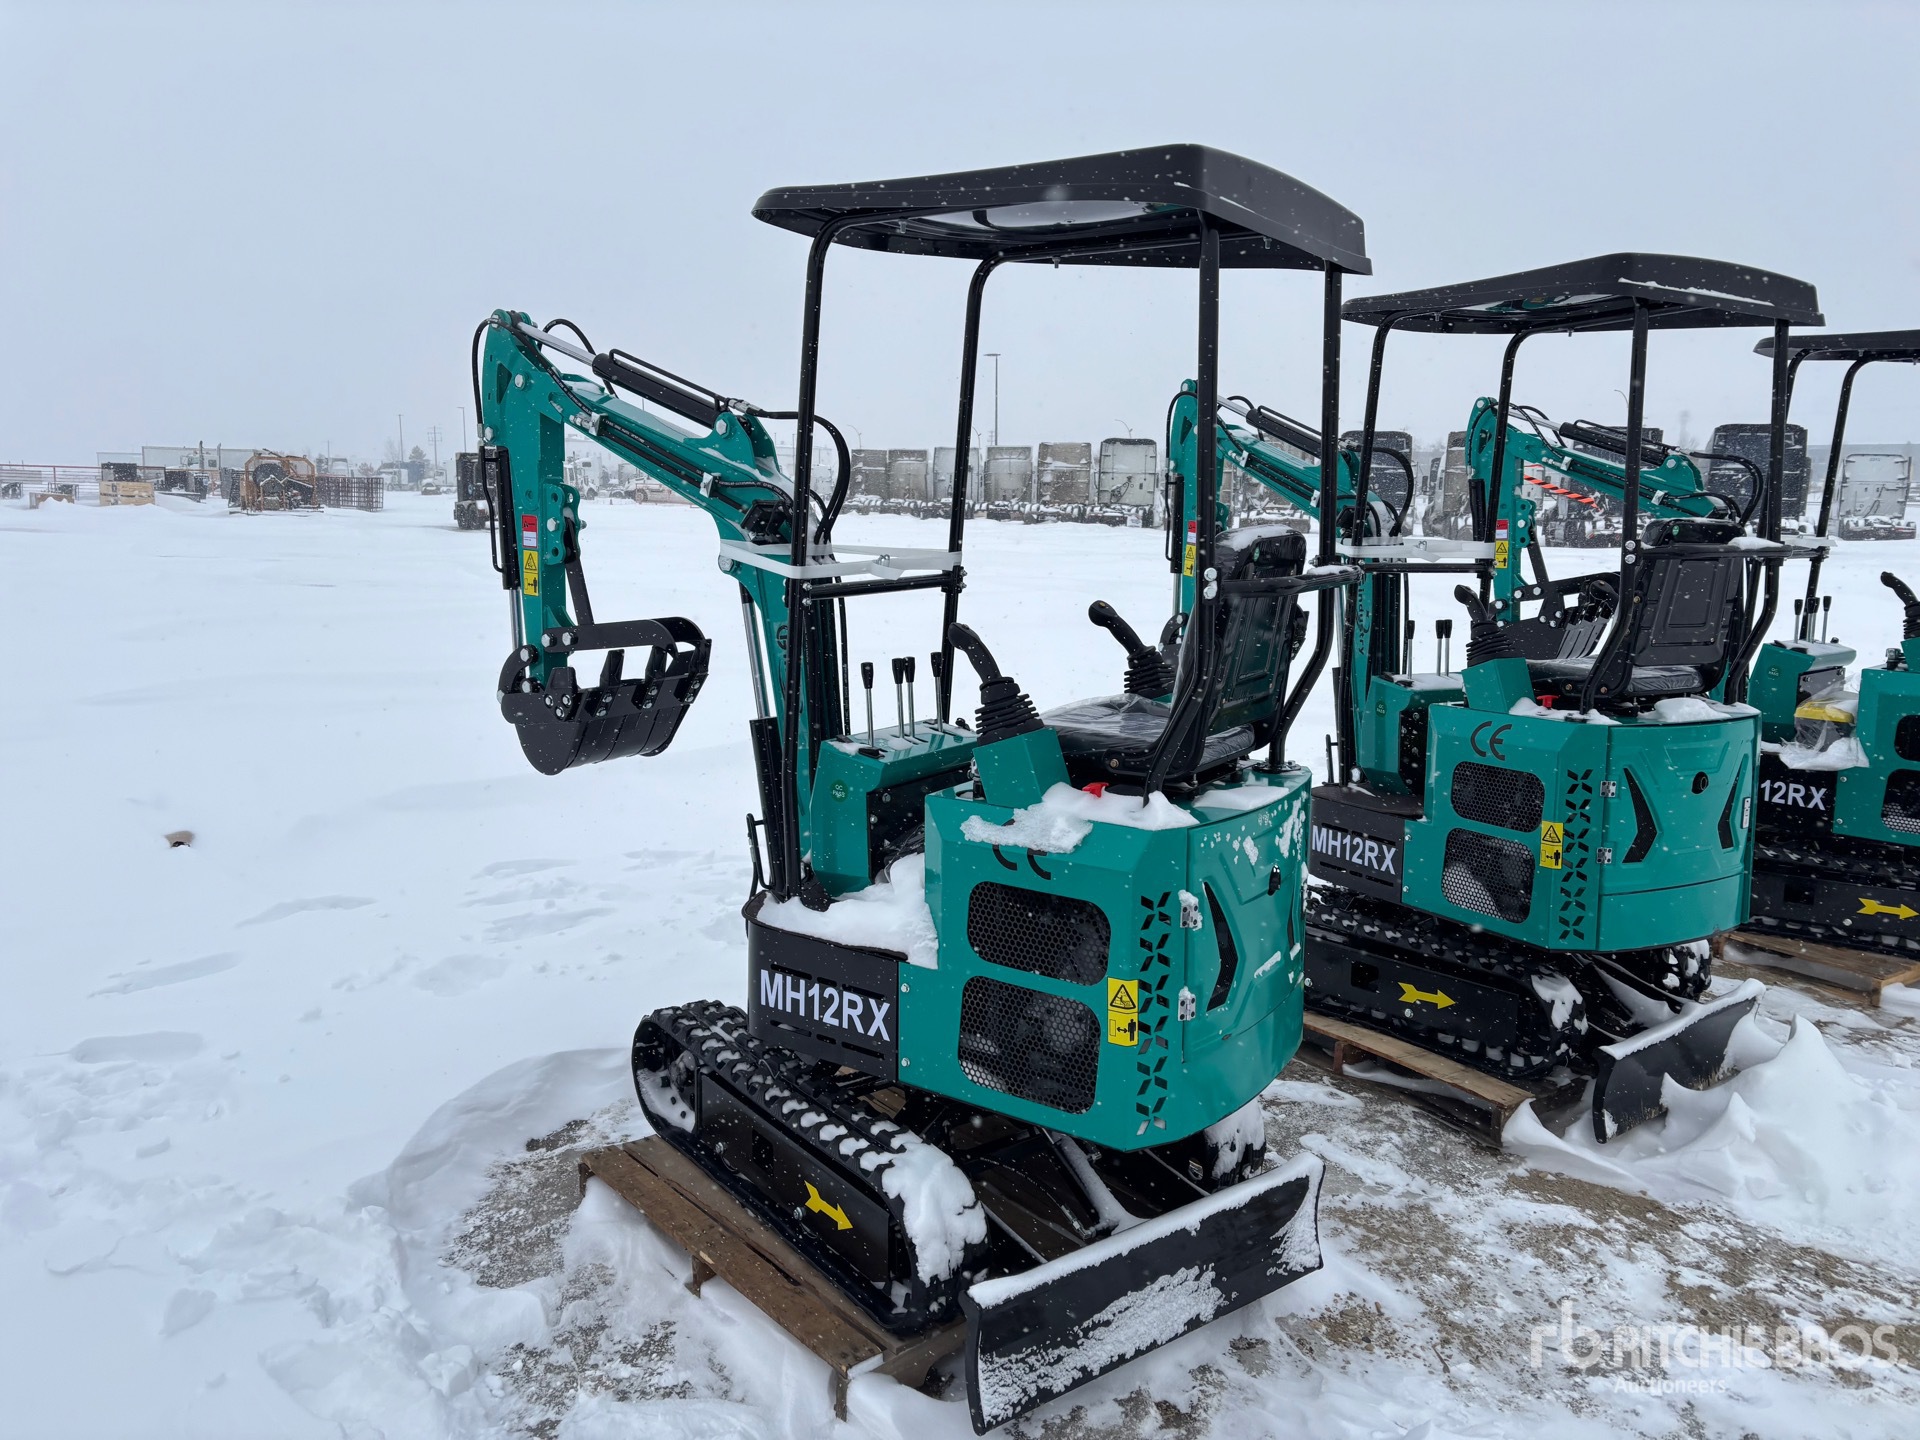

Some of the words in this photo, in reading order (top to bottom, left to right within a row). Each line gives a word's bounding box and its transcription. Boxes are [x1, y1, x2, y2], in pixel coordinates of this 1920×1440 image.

[1470, 720, 1513, 761] CE
[1311, 824, 1397, 875] MH12RX
[760, 968, 891, 1042] MH12RX
